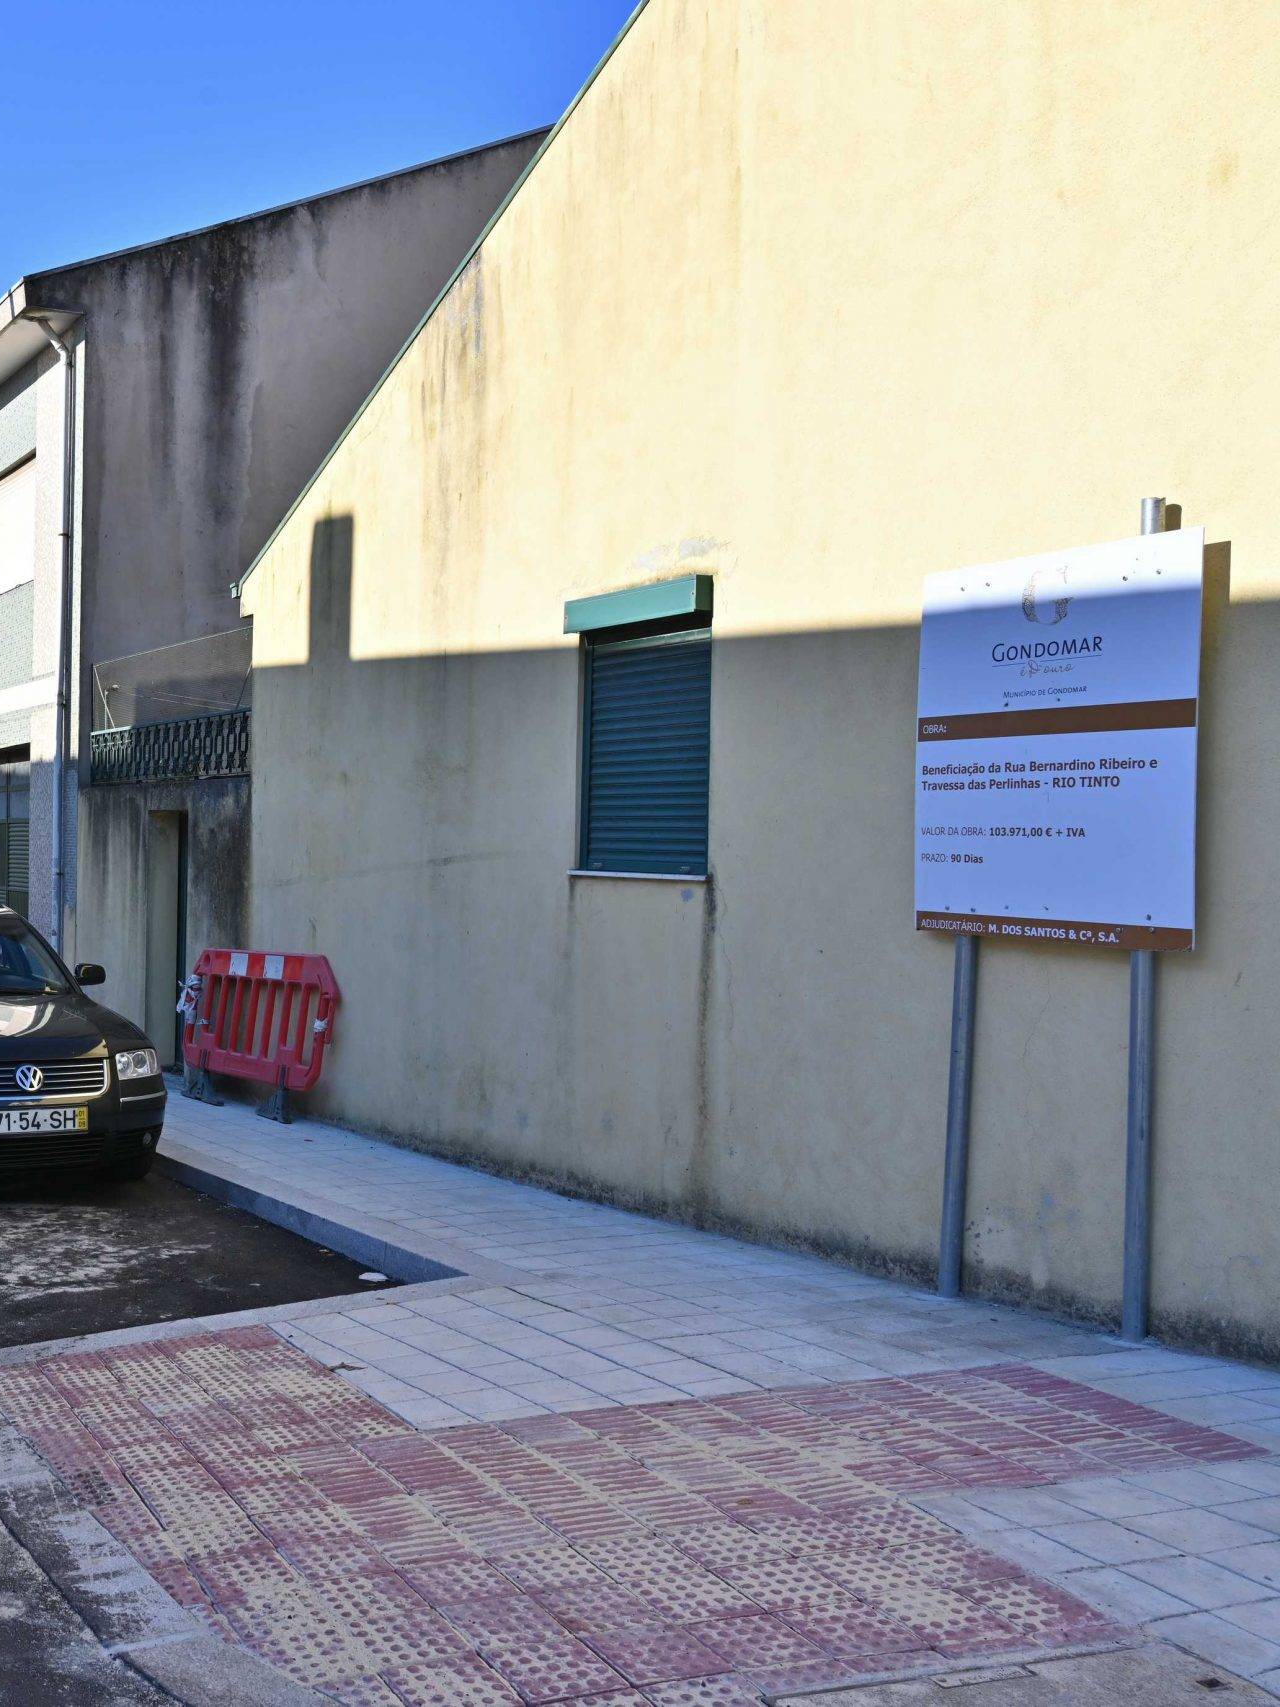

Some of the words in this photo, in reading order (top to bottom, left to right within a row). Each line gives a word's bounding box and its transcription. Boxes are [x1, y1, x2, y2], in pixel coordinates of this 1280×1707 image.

[992, 636, 1102, 662] GONDOMAR
[1047, 686, 1087, 696] GONDOMAR
[922, 724, 947, 734] OBRA:
[922, 763, 985, 776] Beneficiação
[988, 763, 1001, 773] da
[1004, 762, 1026, 773] Rua
[1029, 759, 1095, 772] Bernardino
[1100, 757, 1145, 770] Ribeiro
[1150, 759, 1158, 768] e
[922, 780, 965, 791] Travessa
[968, 779, 986, 790] das
[989, 778, 1041, 790] Perlinhas
[1052, 777, 1076, 788] RIO
[1079, 776, 1120, 788] TINTO
[921, 826, 946, 836] VALOR
[948, 826, 959, 836] DA
[961, 827, 986, 836] OBRA:
[989, 827, 1043, 838] 103.971,00
[1045, 828, 1053, 837] €
[1056, 829, 1063, 837] +
[1066, 828, 1086, 837] IVA
[921, 852, 948, 863] PRAZO:
[950, 853, 962, 863] 90
[964, 854, 984, 864] Dias
[921, 918, 985, 933] ADJUDICATÁRIO:
[988, 923, 1000, 934] M.
[1002, 924, 1021, 935] DOS
[1024, 926, 1066, 939] SANTOS
[1069, 929, 1077, 940] &
[1098, 931, 1119, 943] S.A.
